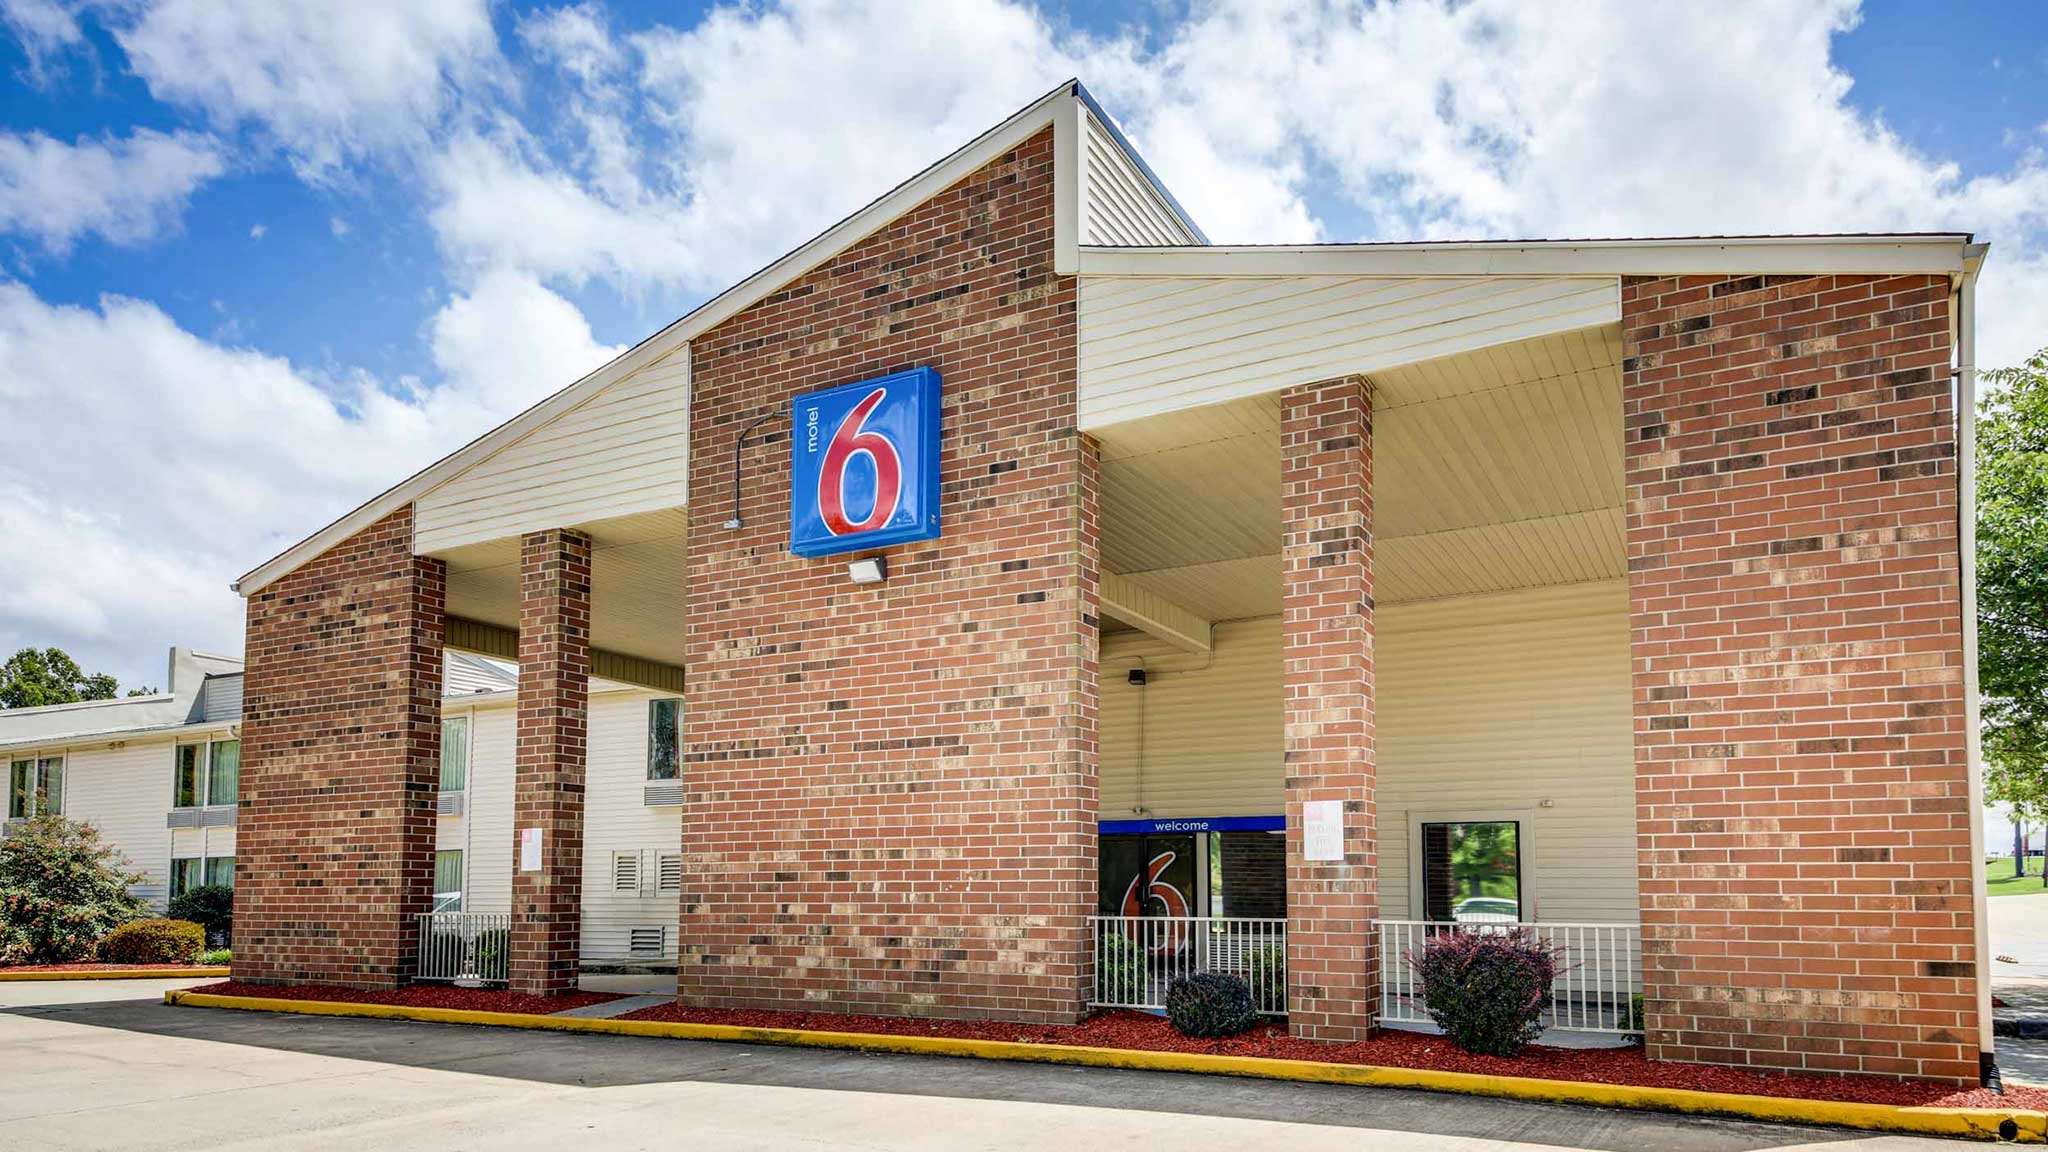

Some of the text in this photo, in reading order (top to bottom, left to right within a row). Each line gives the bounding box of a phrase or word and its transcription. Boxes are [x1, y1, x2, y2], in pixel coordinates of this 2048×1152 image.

[808, 407, 818, 453] motel
[818, 387, 901, 536] 6
[1155, 820, 1209, 831] welcome
[1120, 851, 1190, 956] 6
